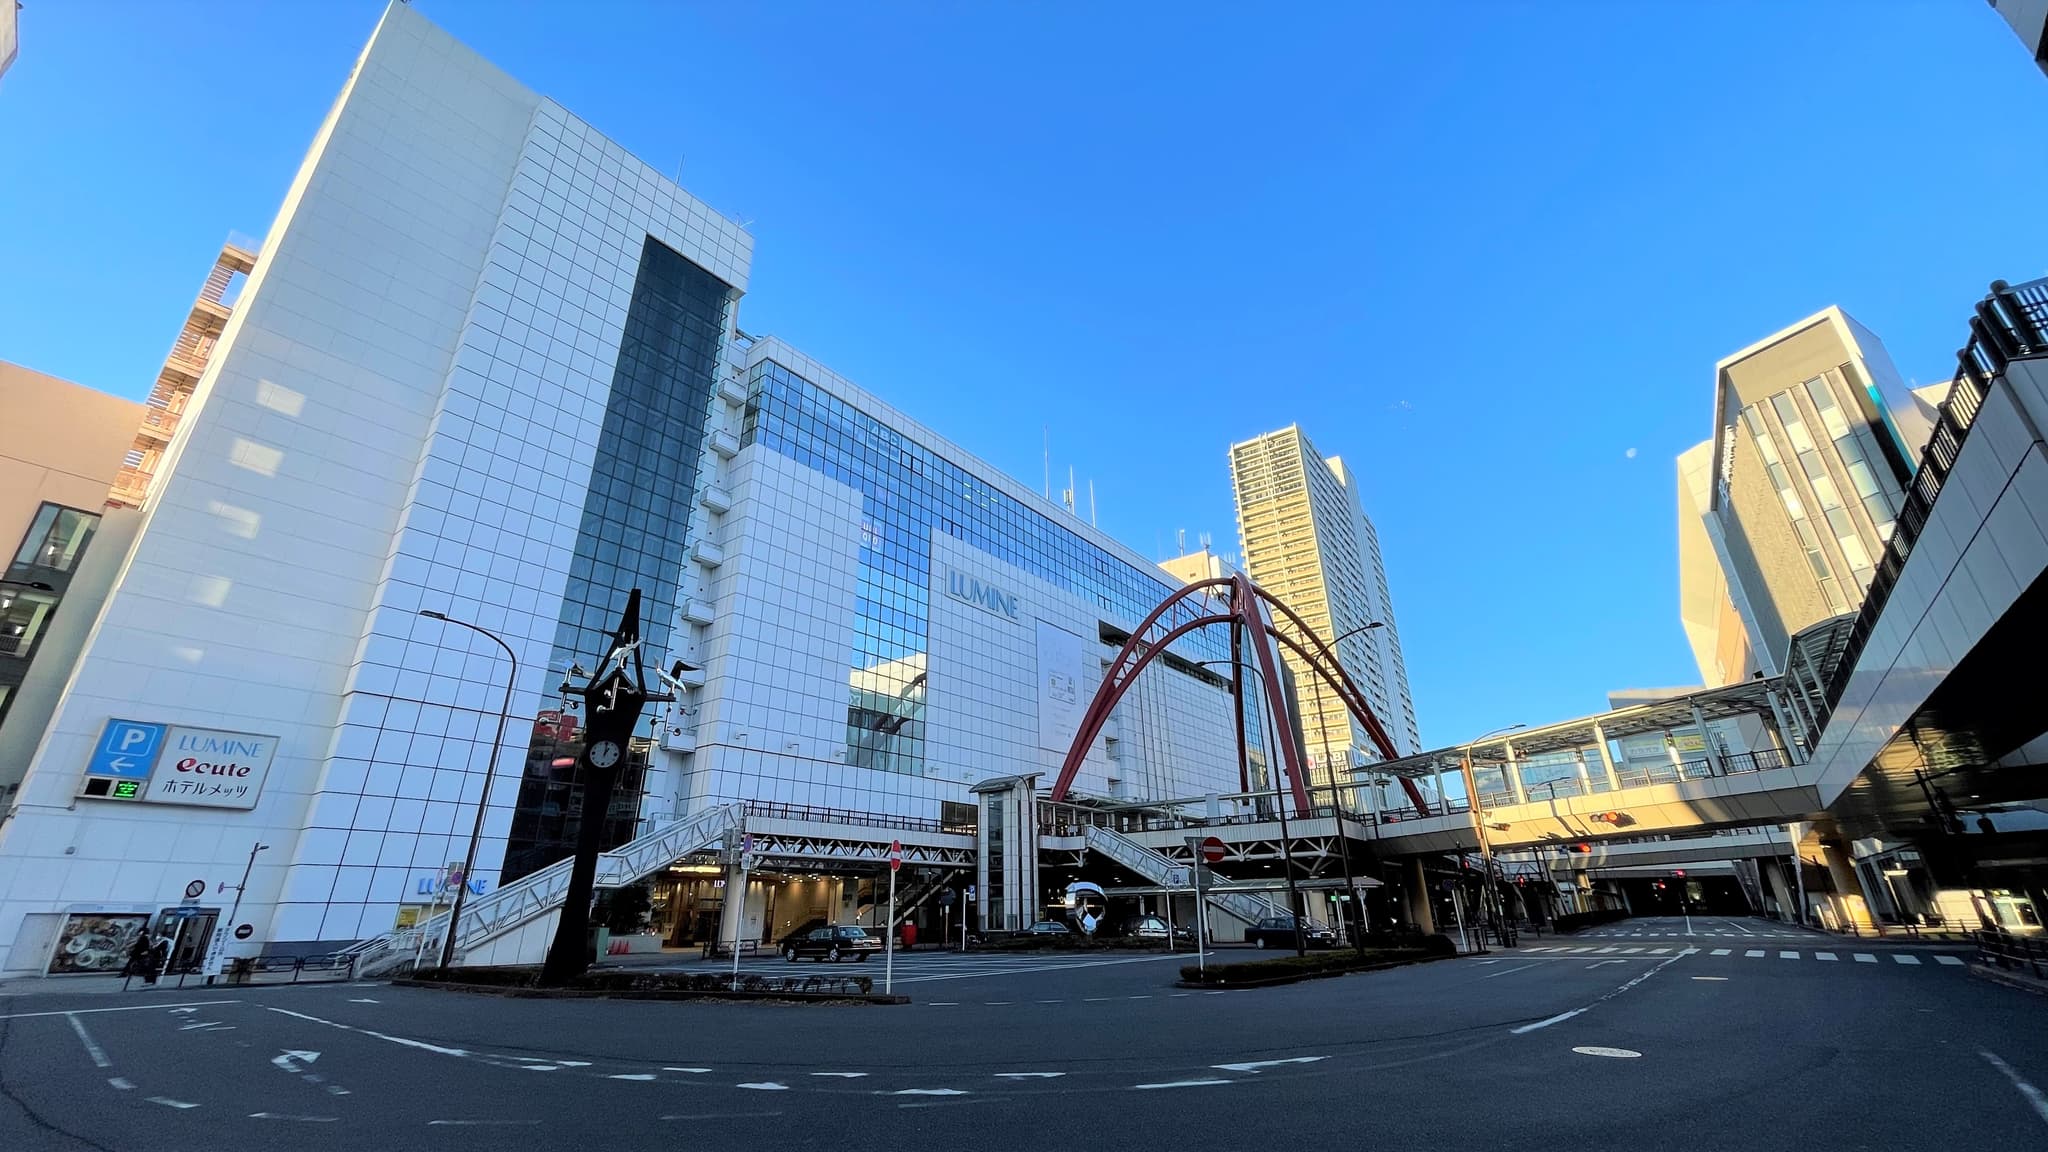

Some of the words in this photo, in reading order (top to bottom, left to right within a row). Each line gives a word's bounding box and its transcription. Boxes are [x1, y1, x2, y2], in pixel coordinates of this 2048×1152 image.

[951, 570, 1018, 619] LUMINE
[121, 729, 146, 750] P
[179, 735, 264, 758] LUMINE
[176, 758, 250, 777] ecute
[115, 782, 138, 798] 空
[162, 779, 248, 797] ホテルメッツ
[418, 878, 487, 895] LUNE
